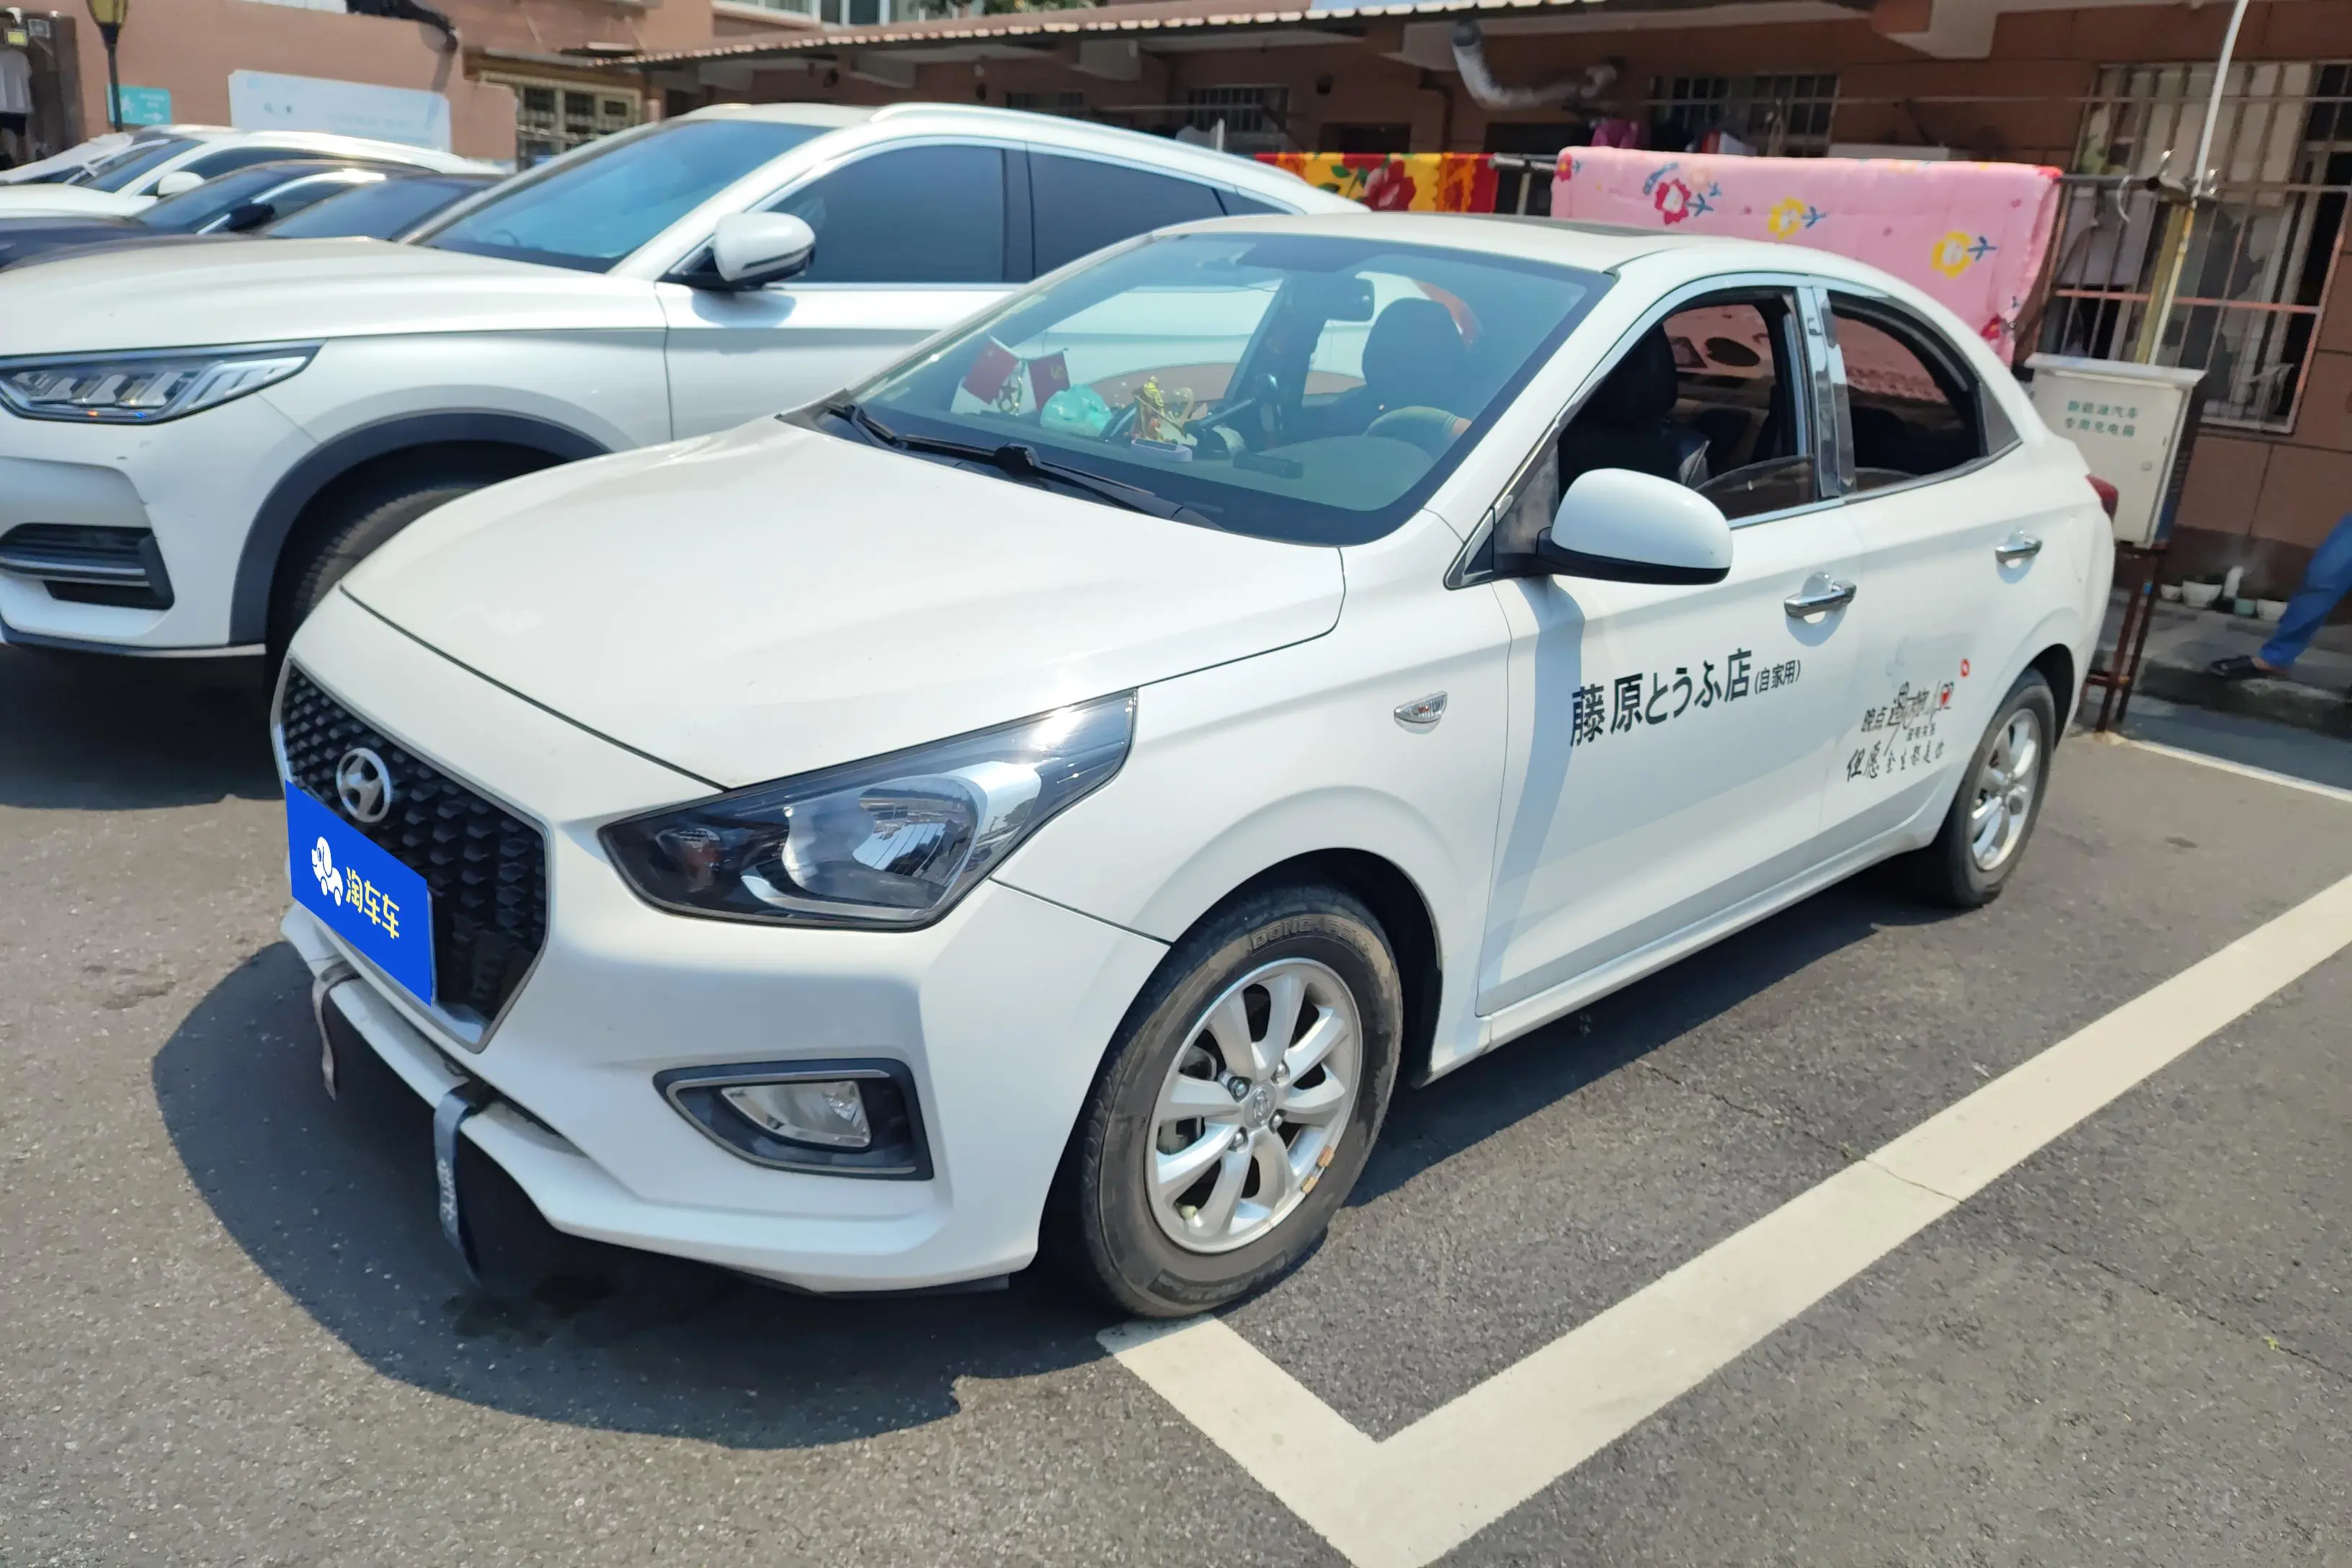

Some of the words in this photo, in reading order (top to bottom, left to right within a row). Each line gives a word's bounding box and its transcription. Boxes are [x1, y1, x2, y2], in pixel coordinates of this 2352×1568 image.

[1570, 648, 1752, 747] 藤原とうふ店
